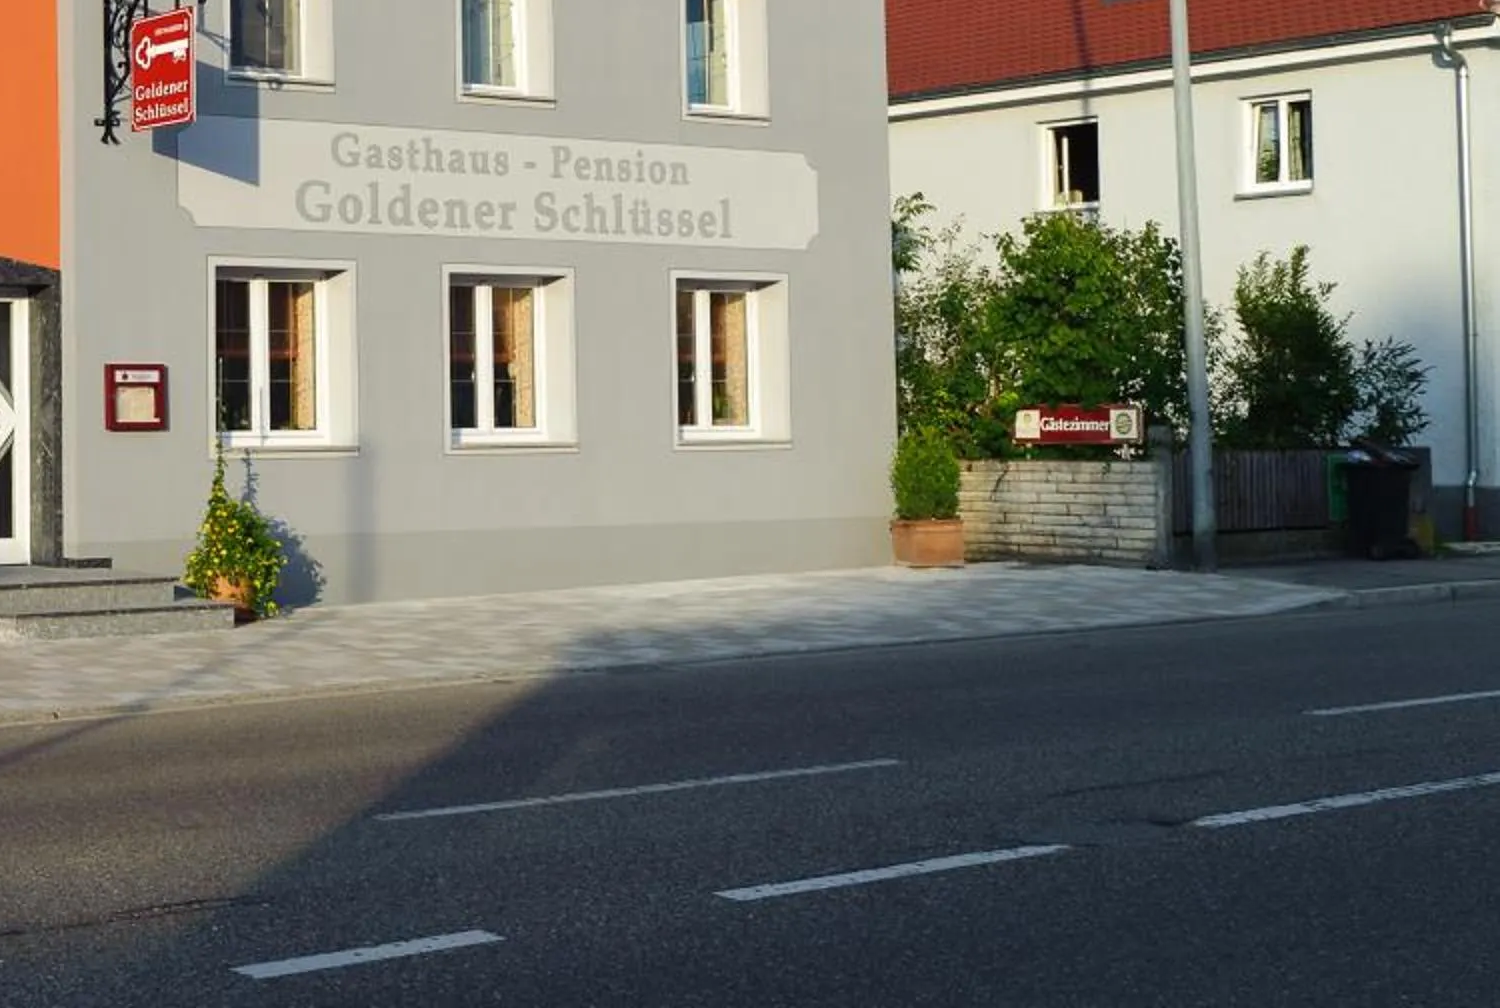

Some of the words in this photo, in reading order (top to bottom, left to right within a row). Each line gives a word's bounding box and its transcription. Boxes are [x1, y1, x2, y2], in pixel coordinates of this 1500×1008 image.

[135, 80, 188, 101] Goldener
[135, 97, 188, 122] Schlüssel
[330, 132, 509, 176] Gasthaus
[550, 145, 690, 185] Pension
[295, 179, 517, 230] Goldener
[533, 191, 733, 238] Schlüssel
